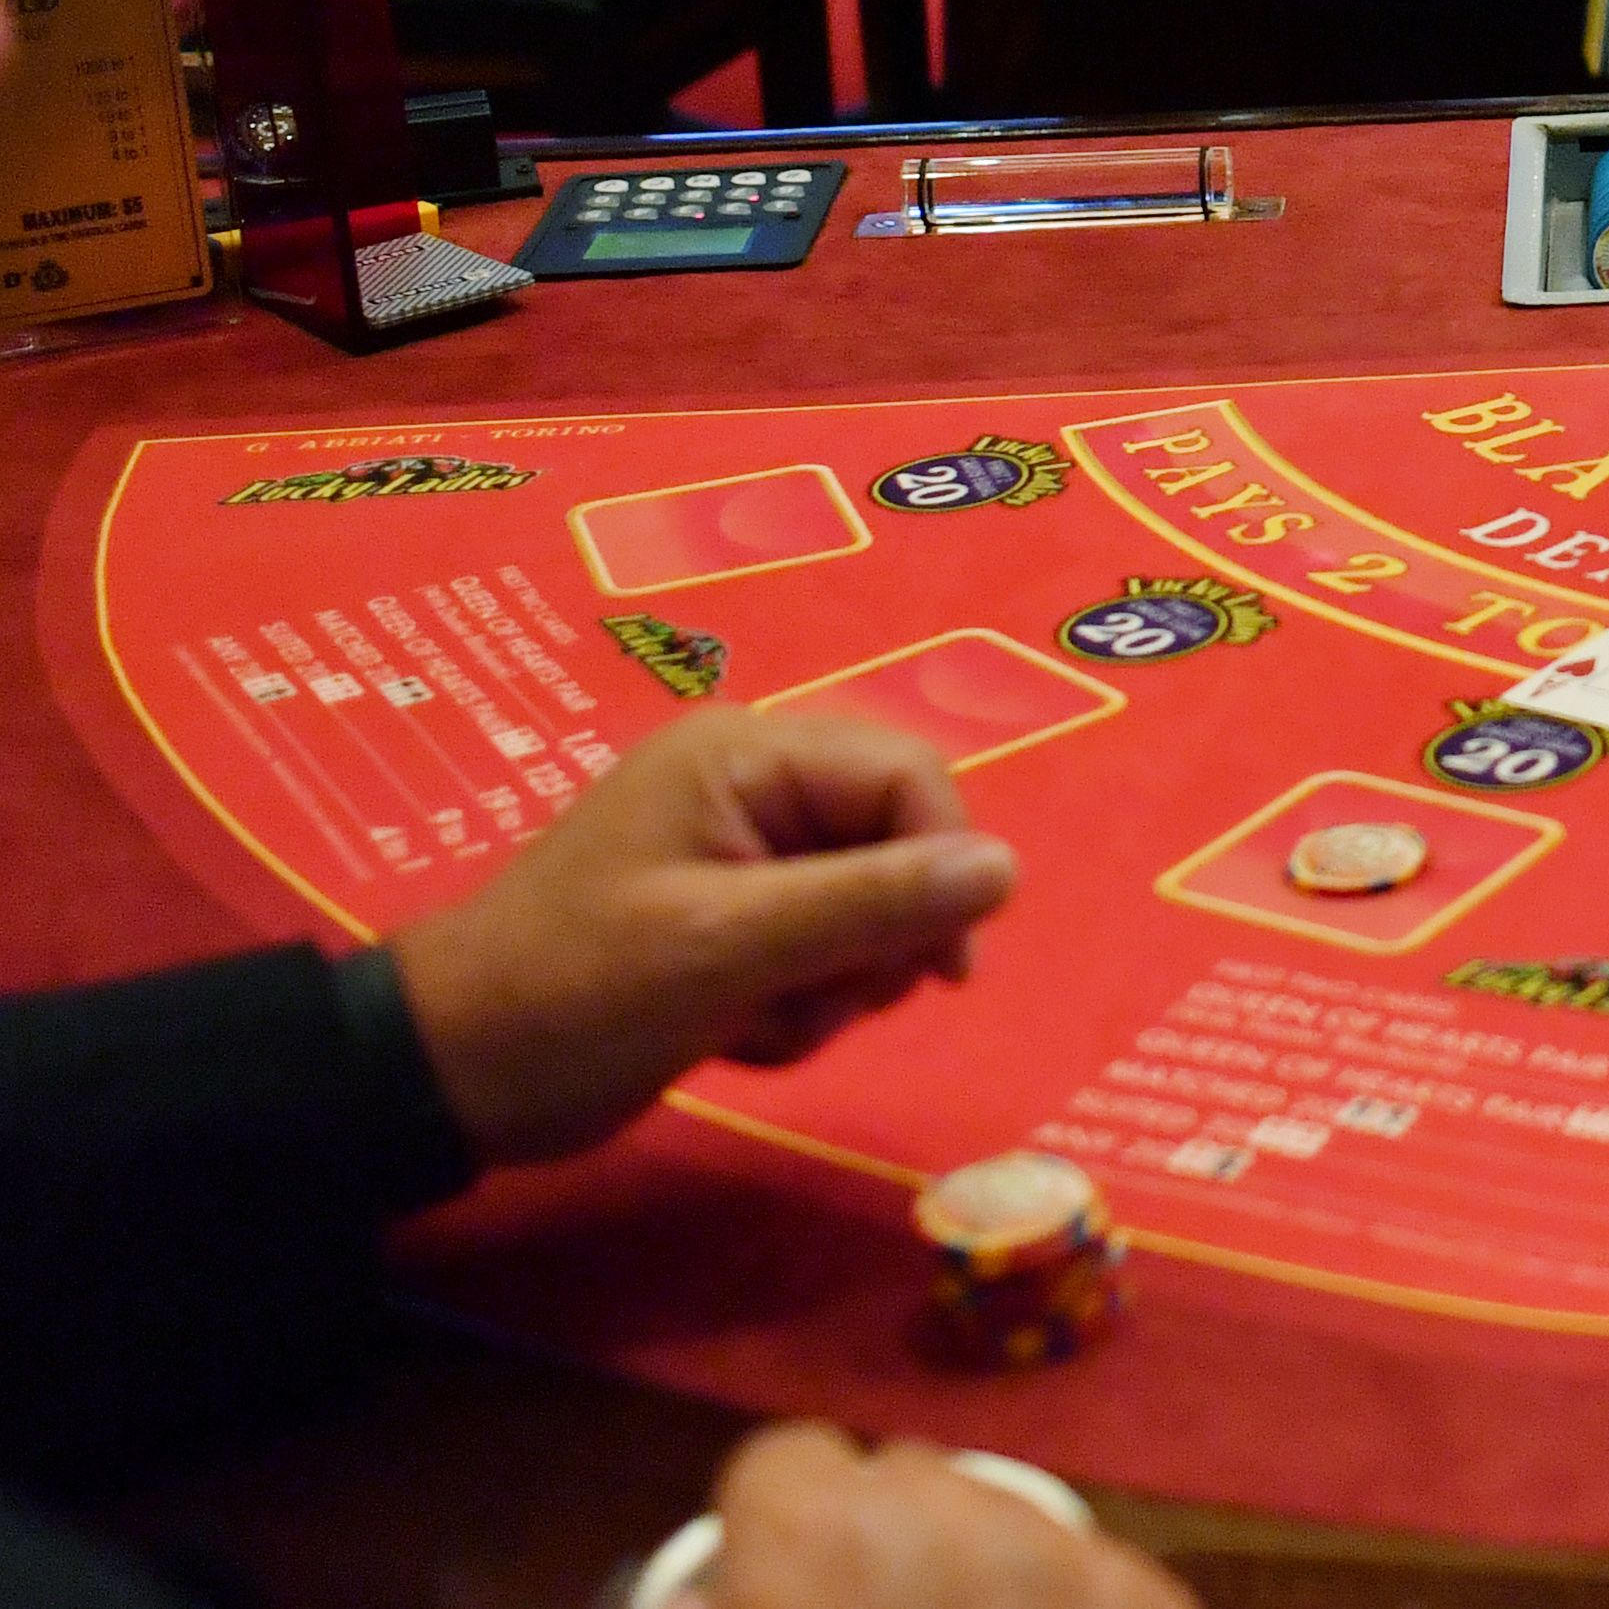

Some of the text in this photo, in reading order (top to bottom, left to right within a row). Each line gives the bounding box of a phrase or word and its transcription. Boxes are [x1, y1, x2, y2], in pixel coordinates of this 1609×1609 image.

[489, 423, 627, 441] TORINO
[896, 465, 969, 506] 20
[1122, 428, 1604, 658] PAYS 2 TO
[1072, 611, 1177, 657] 20
[1441, 737, 1561, 785] 20
